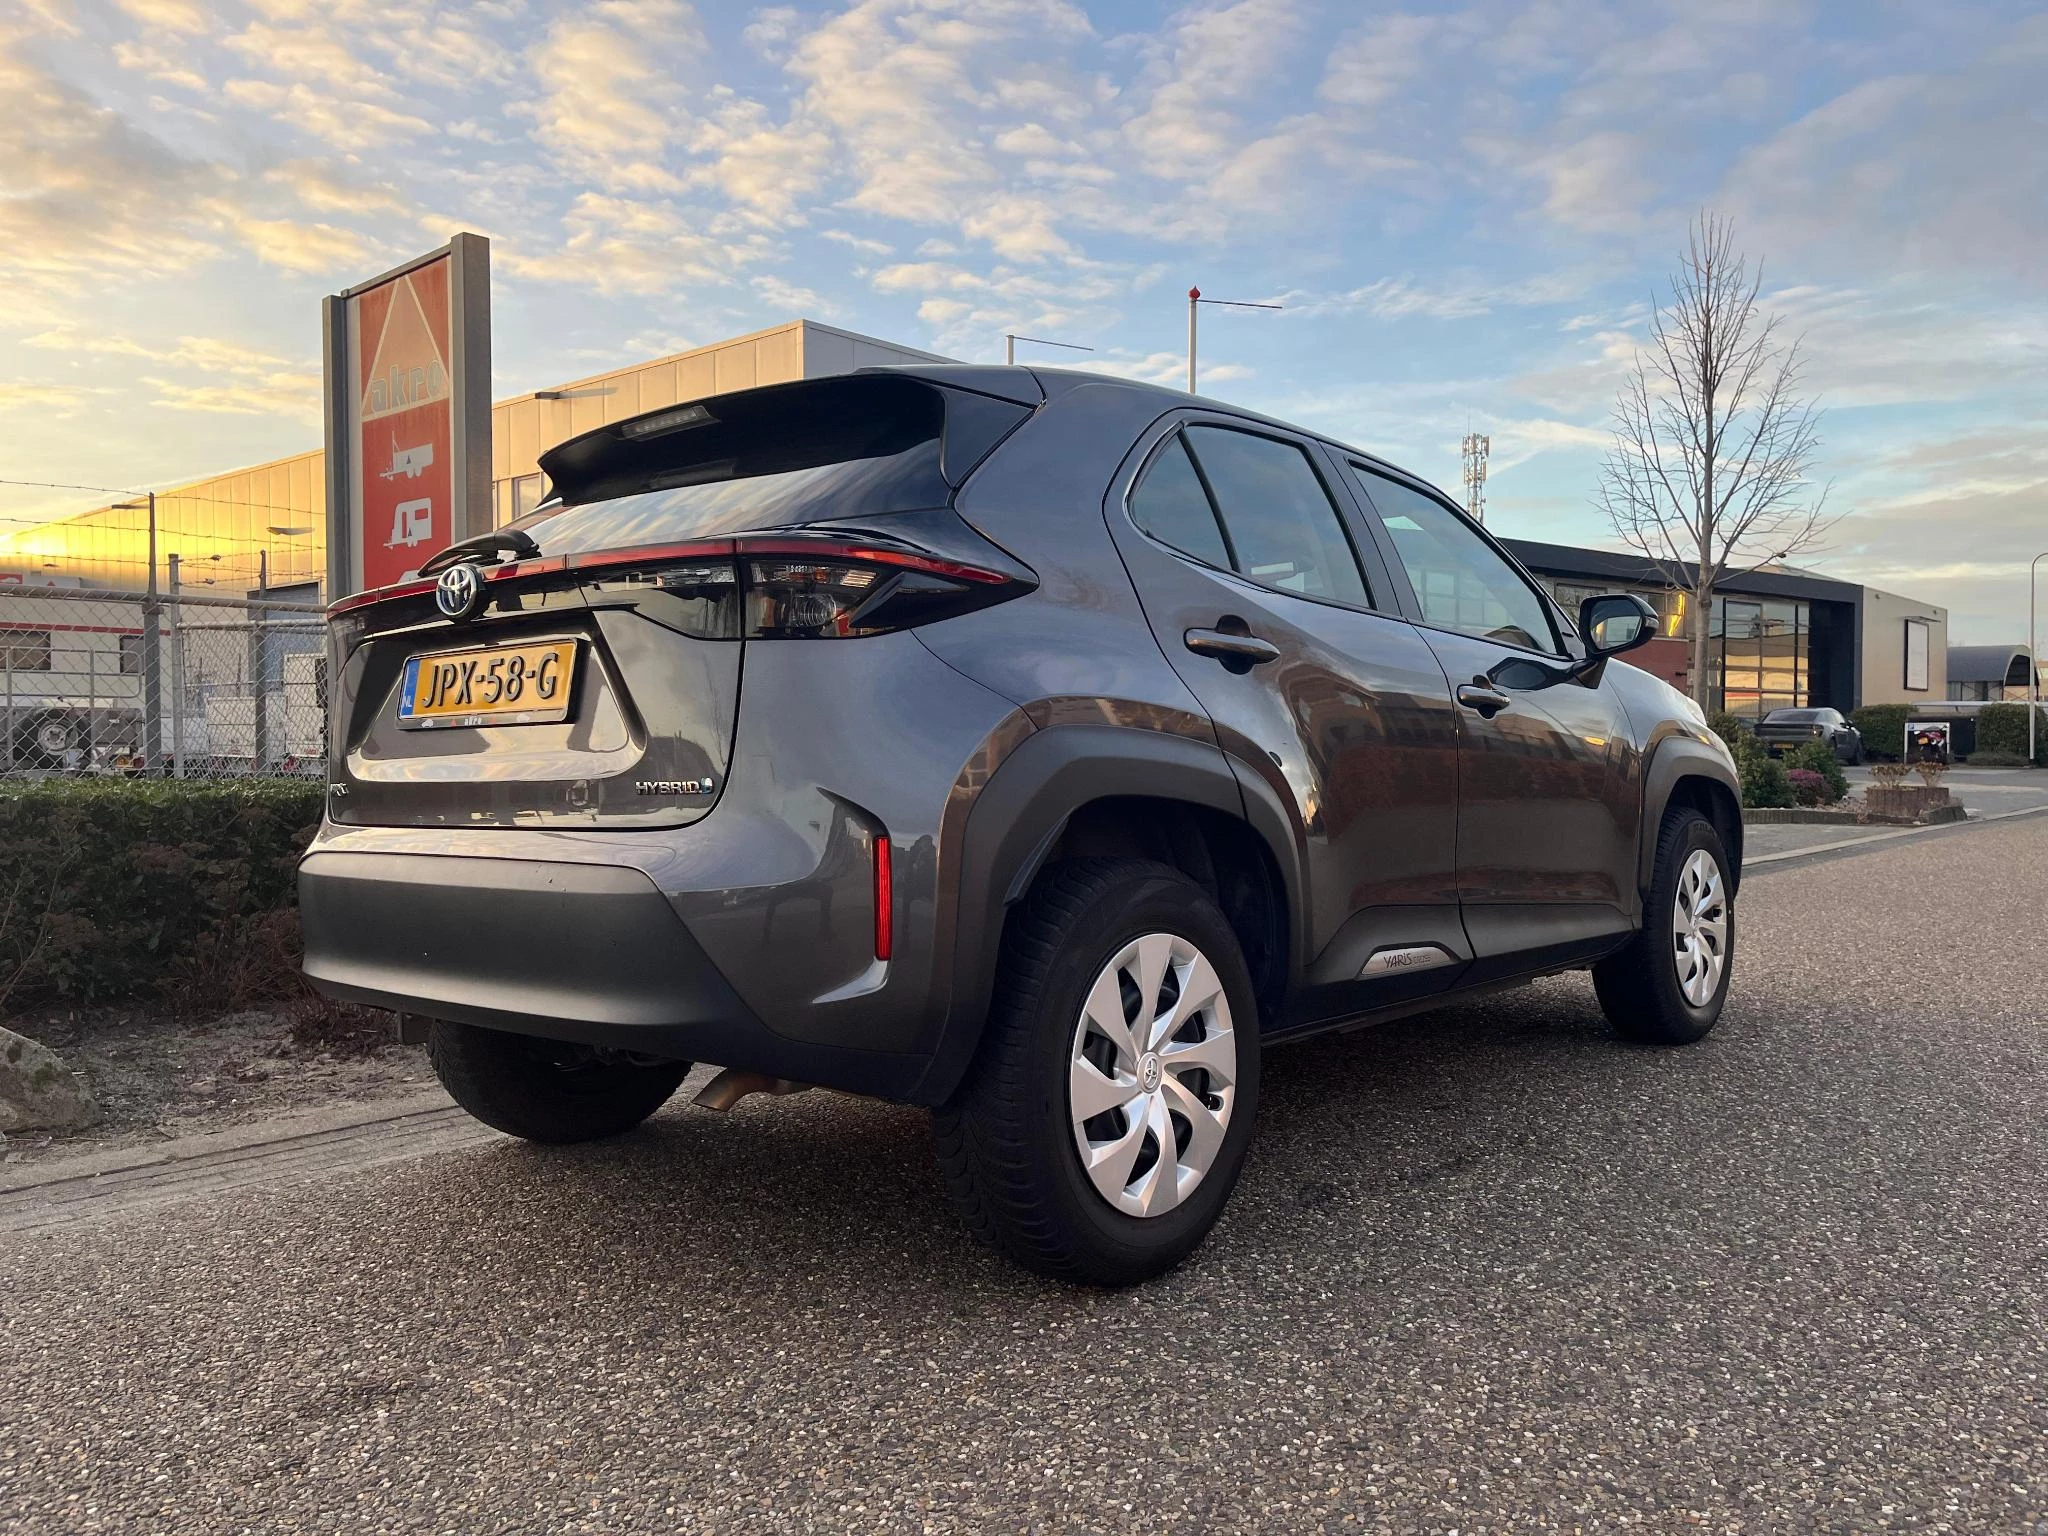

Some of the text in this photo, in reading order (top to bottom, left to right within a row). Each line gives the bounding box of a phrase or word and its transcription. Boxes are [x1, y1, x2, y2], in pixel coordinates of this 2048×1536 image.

[371, 360, 443, 413] akro
[422, 652, 559, 708] JPX-58-G
[402, 695, 413, 708] NL
[635, 781, 700, 795] HYBRID
